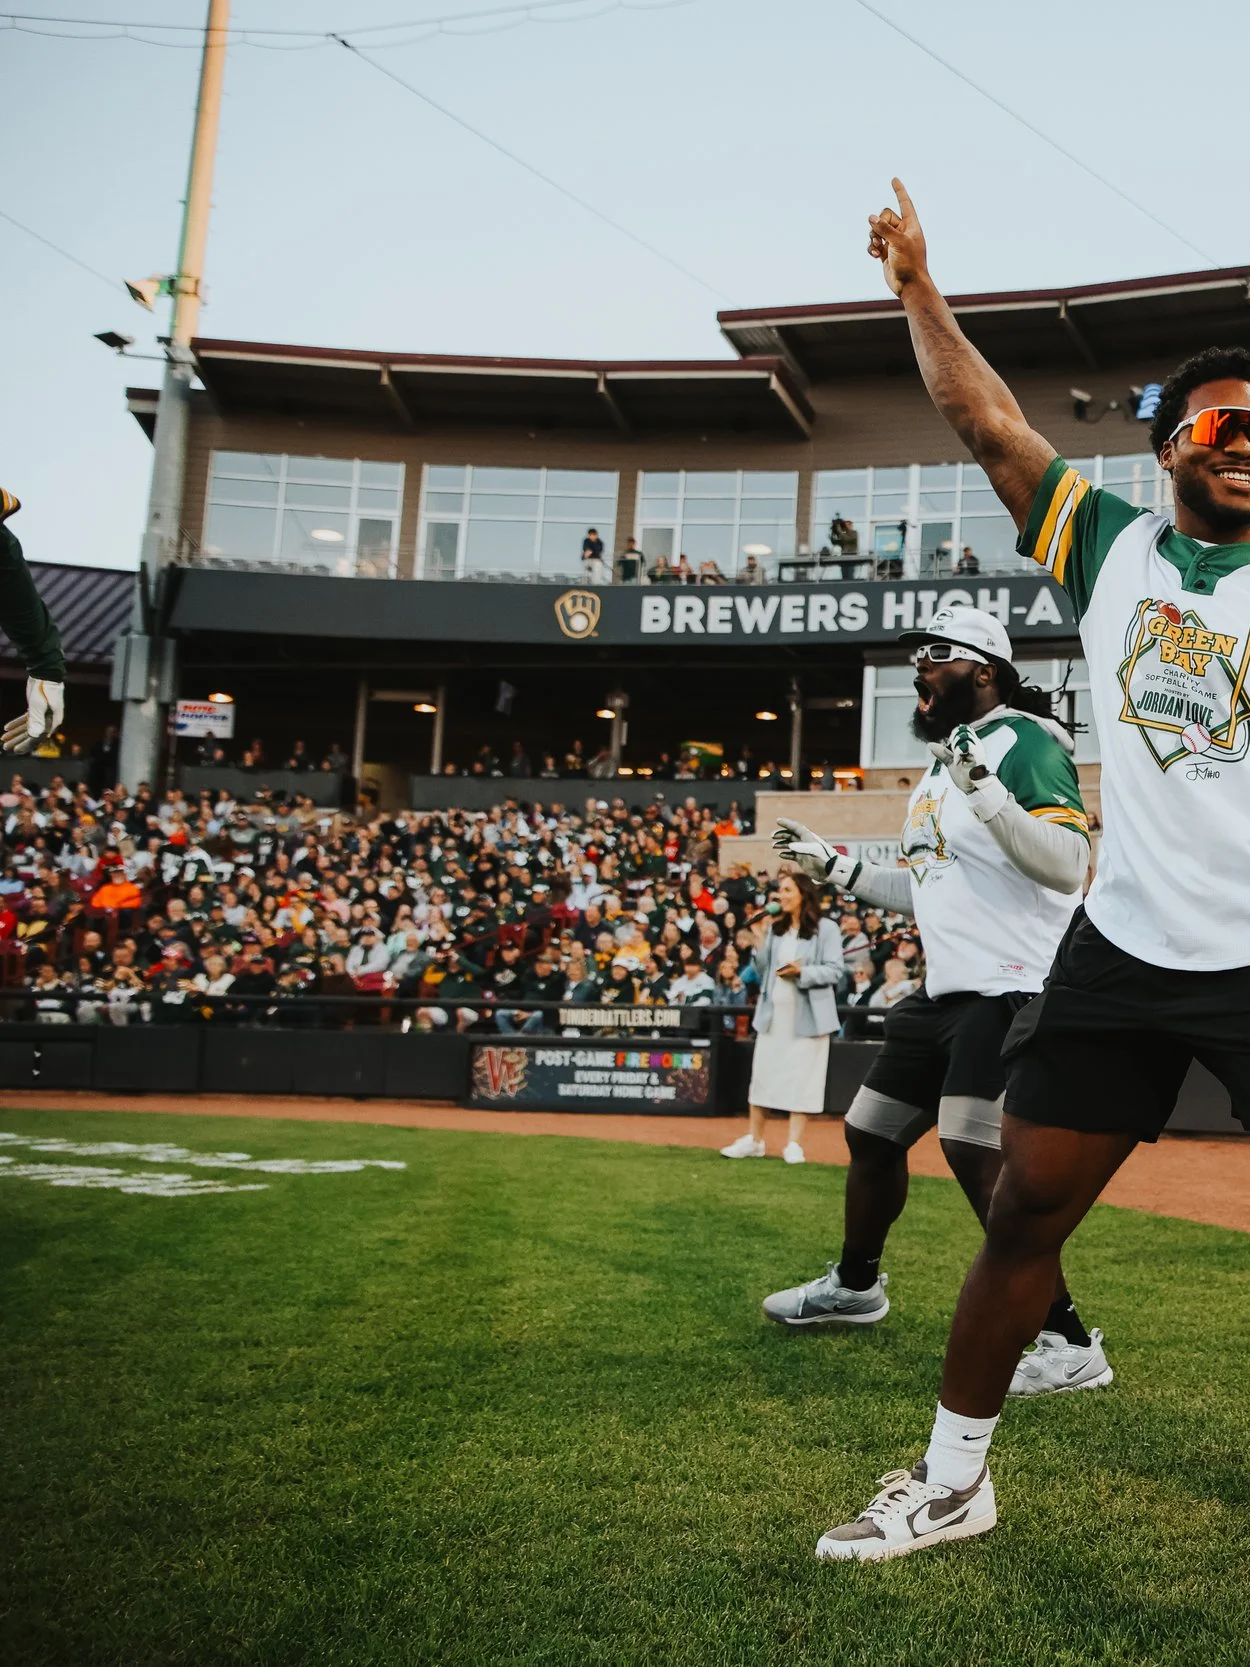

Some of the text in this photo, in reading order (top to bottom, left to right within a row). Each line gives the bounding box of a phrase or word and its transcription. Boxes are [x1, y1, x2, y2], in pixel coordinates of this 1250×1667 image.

[640, 591, 869, 634] BREWERS
[1148, 615, 1238, 657] GREEN
[1160, 639, 1212, 677] BAY
[1145, 674, 1217, 700] SOFTBALL GAME
[1164, 669, 1200, 686] CHARITY
[1136, 690, 1214, 728] JORDAN LOVE
[535, 1051, 615, 1067] POST-GAME
